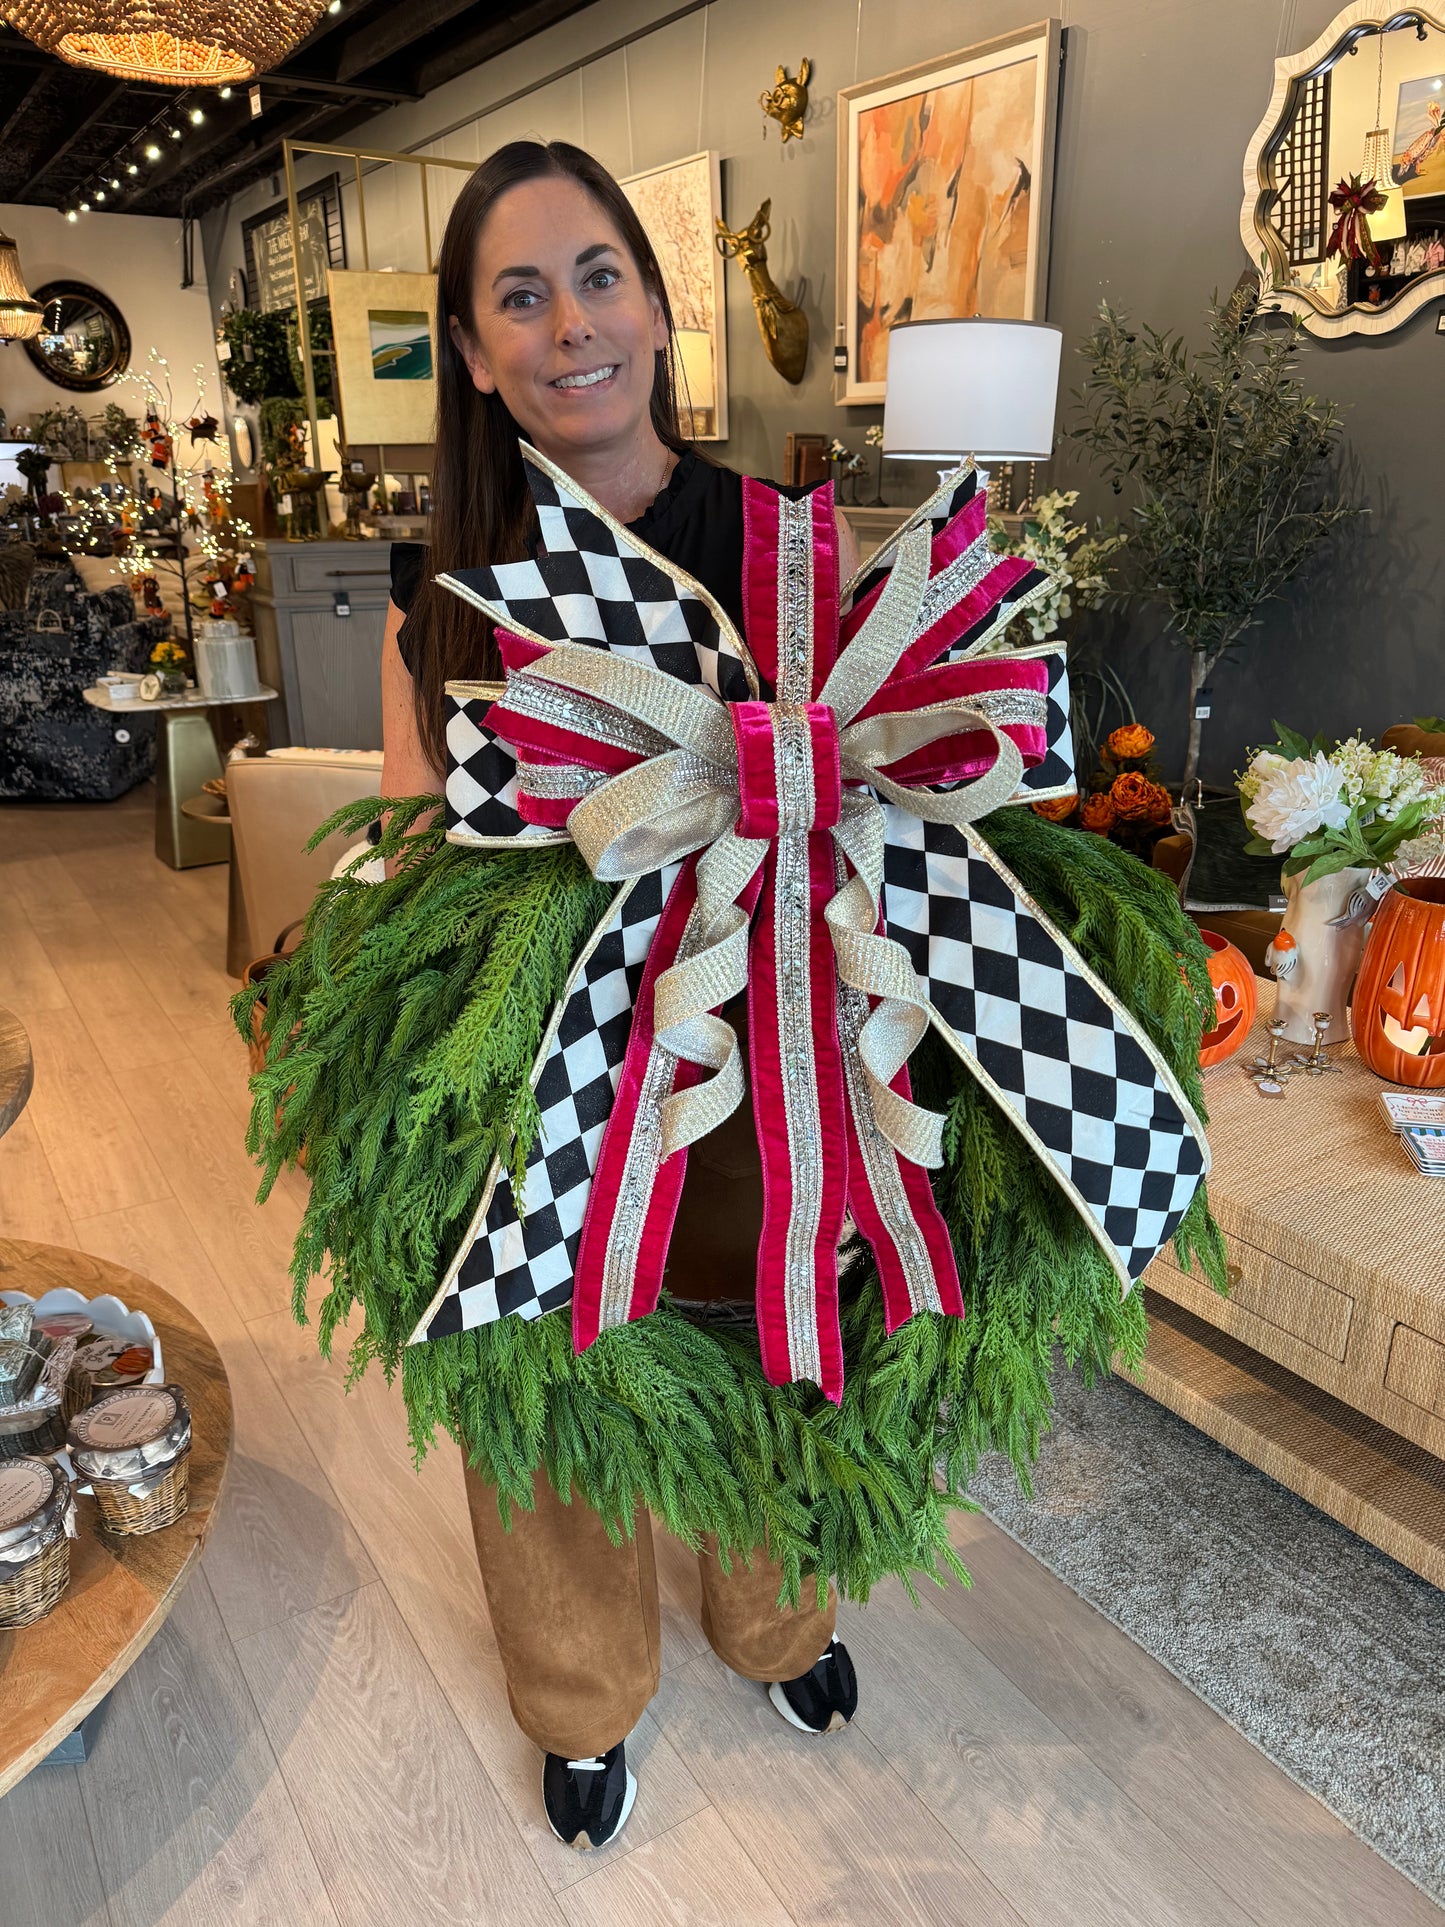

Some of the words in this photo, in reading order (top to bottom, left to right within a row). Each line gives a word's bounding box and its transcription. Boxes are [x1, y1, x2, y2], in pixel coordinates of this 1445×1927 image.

[266, 237, 279, 256] THE
[137, 1402, 155, 1422] PUMPKIN
[7, 1480, 35, 1502] PUMPKIN
